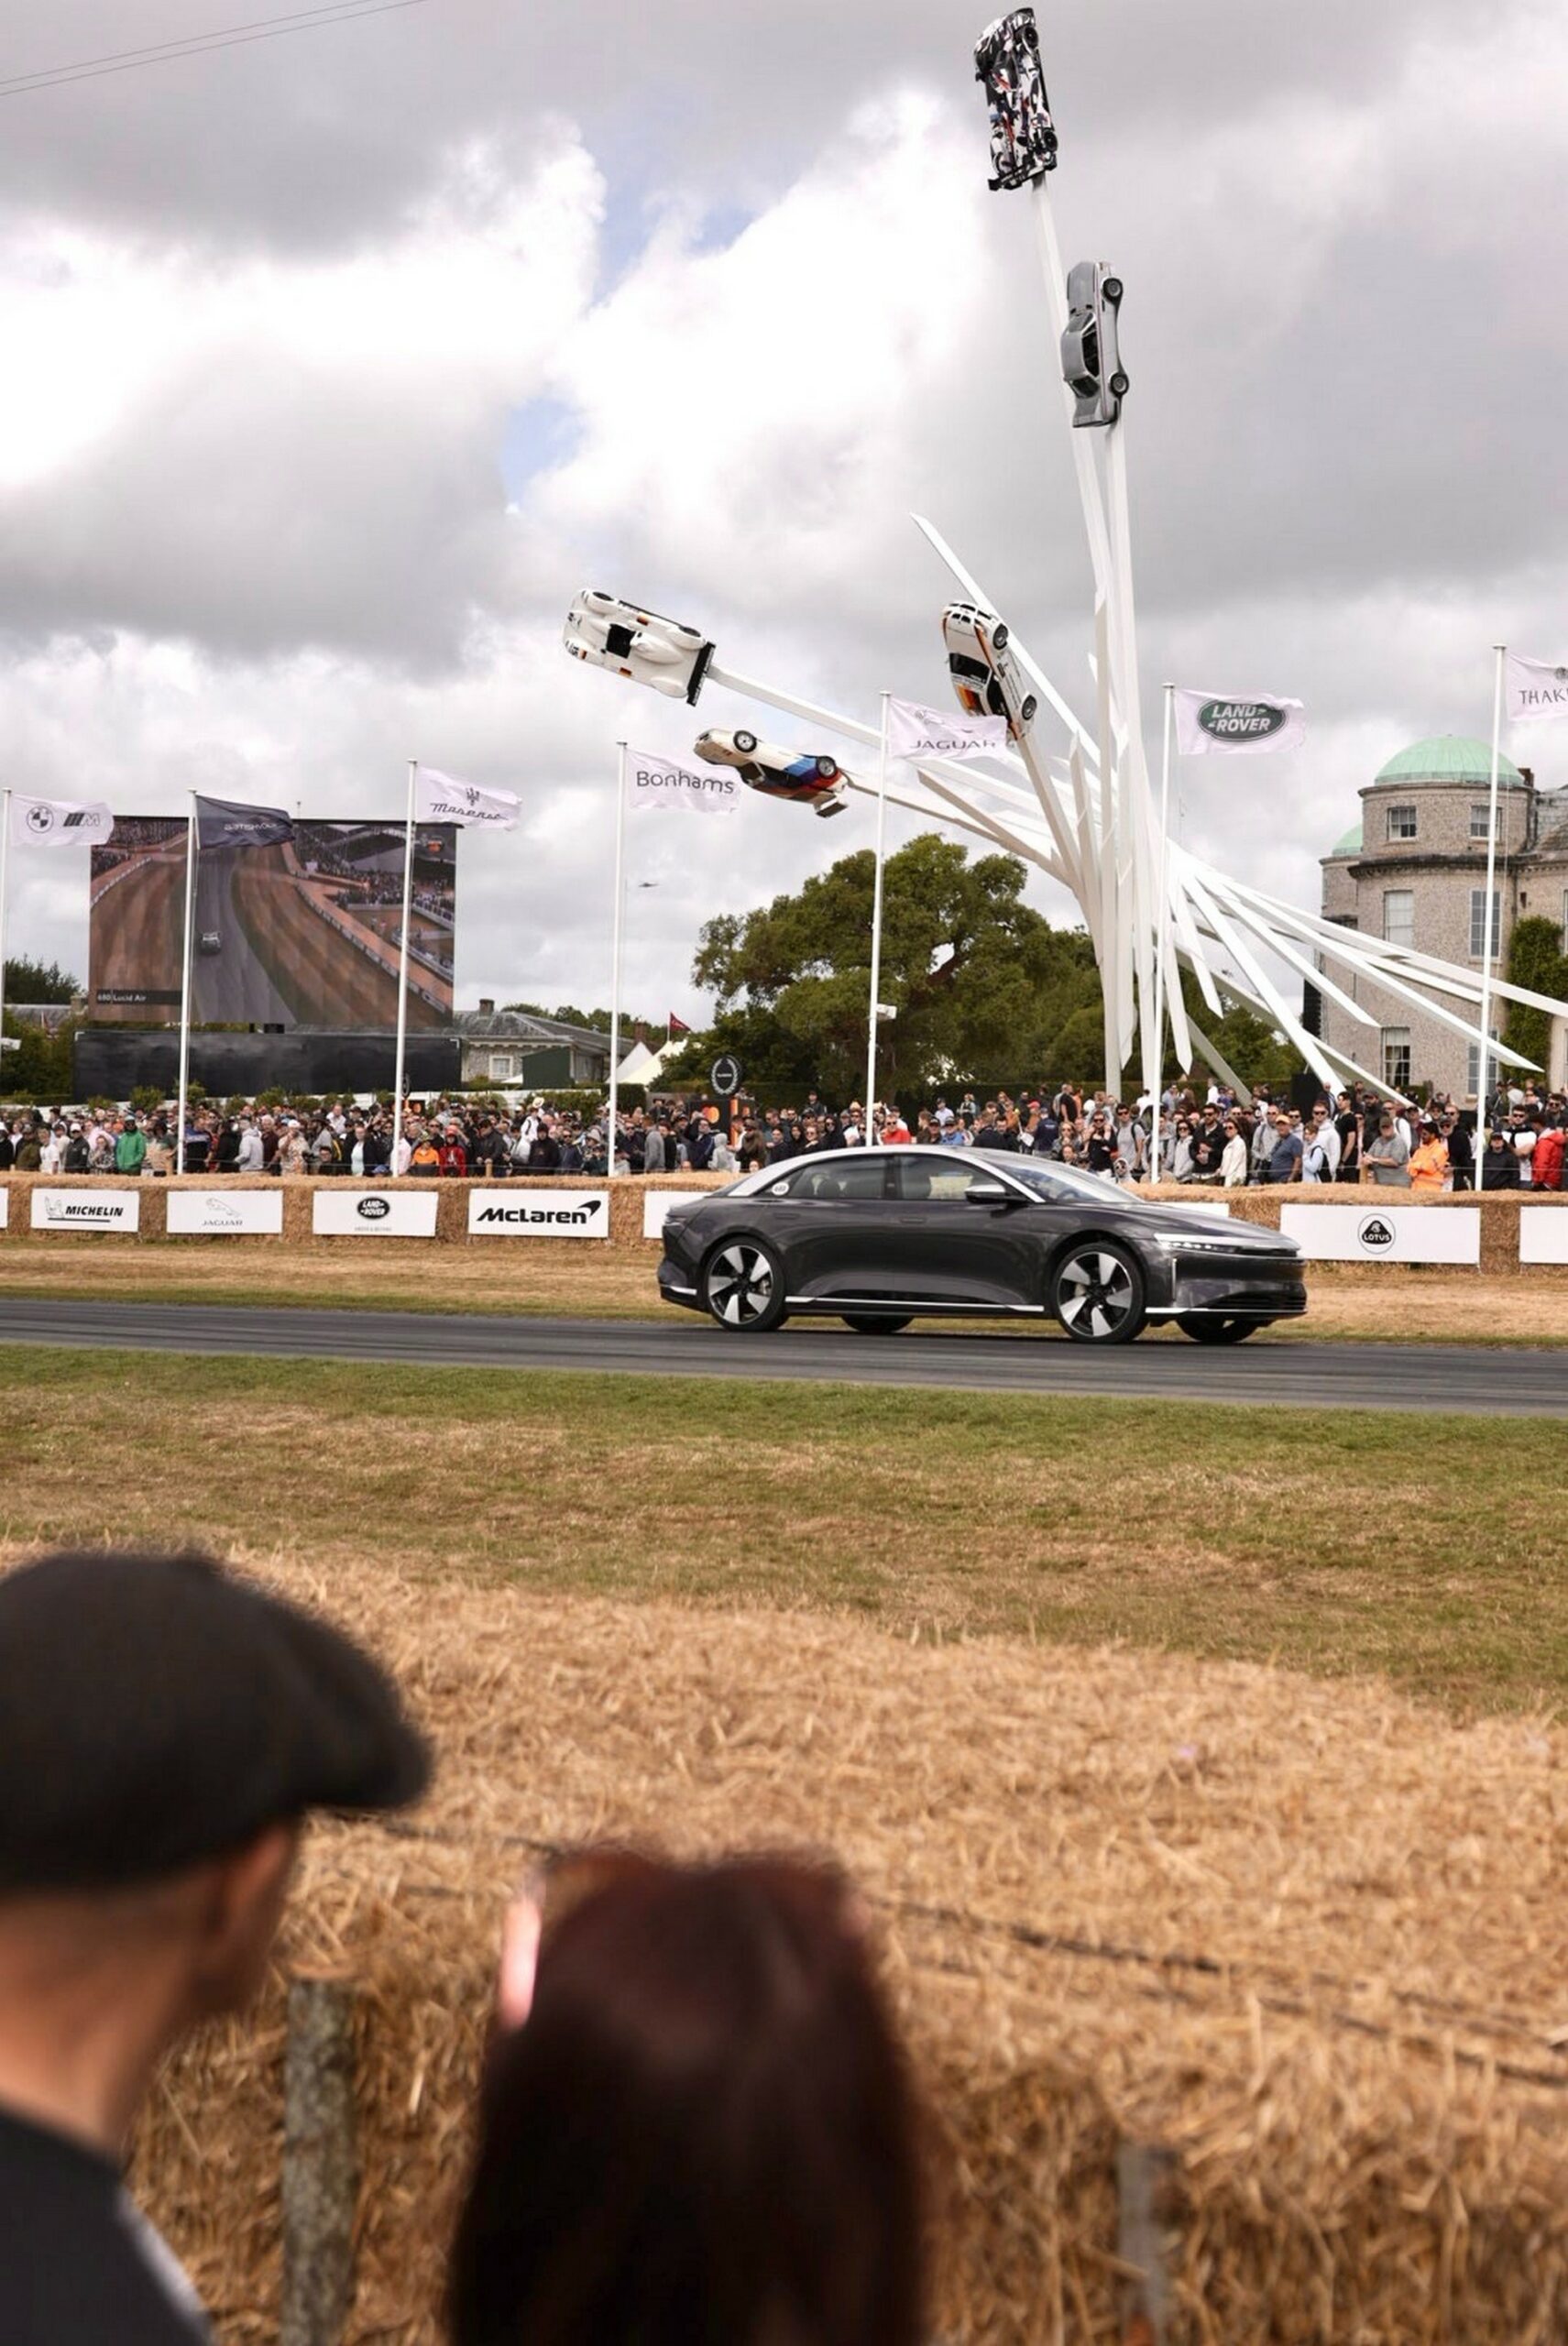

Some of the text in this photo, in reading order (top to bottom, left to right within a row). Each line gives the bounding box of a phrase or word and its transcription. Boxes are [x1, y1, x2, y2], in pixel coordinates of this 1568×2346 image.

[1518, 688, 1568, 705] THAK
[1212, 705, 1256, 718] LAND
[1216, 718, 1271, 732] ROVER
[910, 740, 996, 750] JAGUAR
[636, 771, 734, 795] Bonhams
[113, 993, 133, 1002] Lucid
[135, 993, 147, 1002] Air
[65, 1205, 124, 1217] MICHELIN
[477, 1207, 587, 1224] McLaren
[1363, 1233, 1391, 1242] LOTUS
